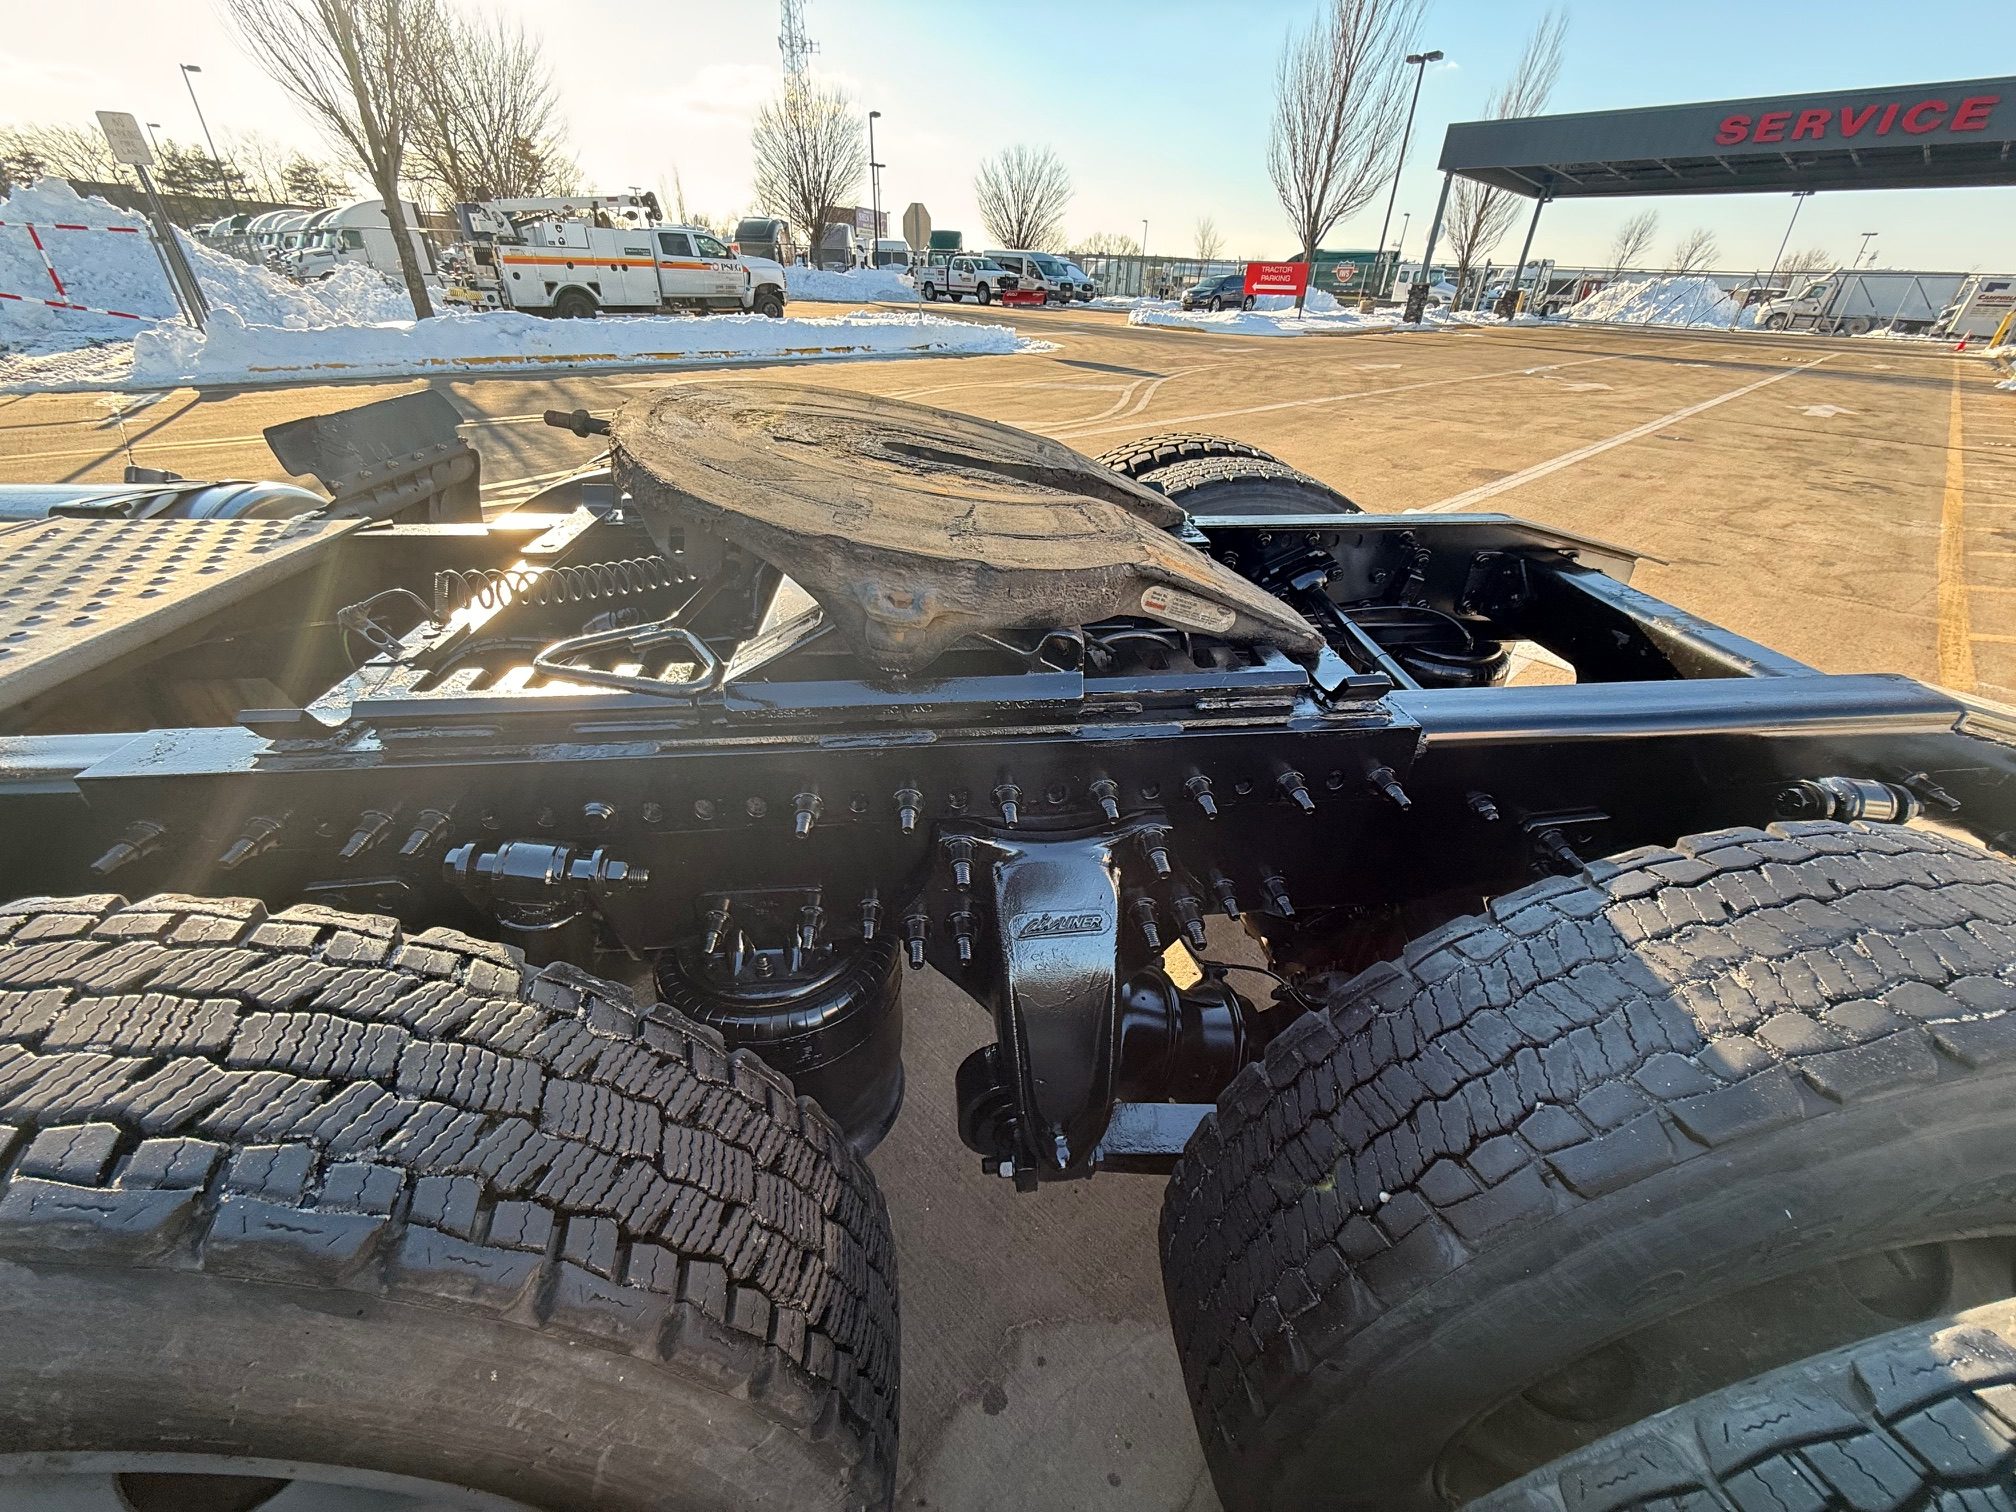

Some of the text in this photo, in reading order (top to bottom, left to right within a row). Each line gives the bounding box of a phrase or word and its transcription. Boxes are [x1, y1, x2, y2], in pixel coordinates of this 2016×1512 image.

[1714, 96, 2000, 146] SERVICE
[721, 263, 741, 271] PSEG
[1261, 265, 1293, 273] TRACTOR
[1260, 274, 1291, 282] PARKING
